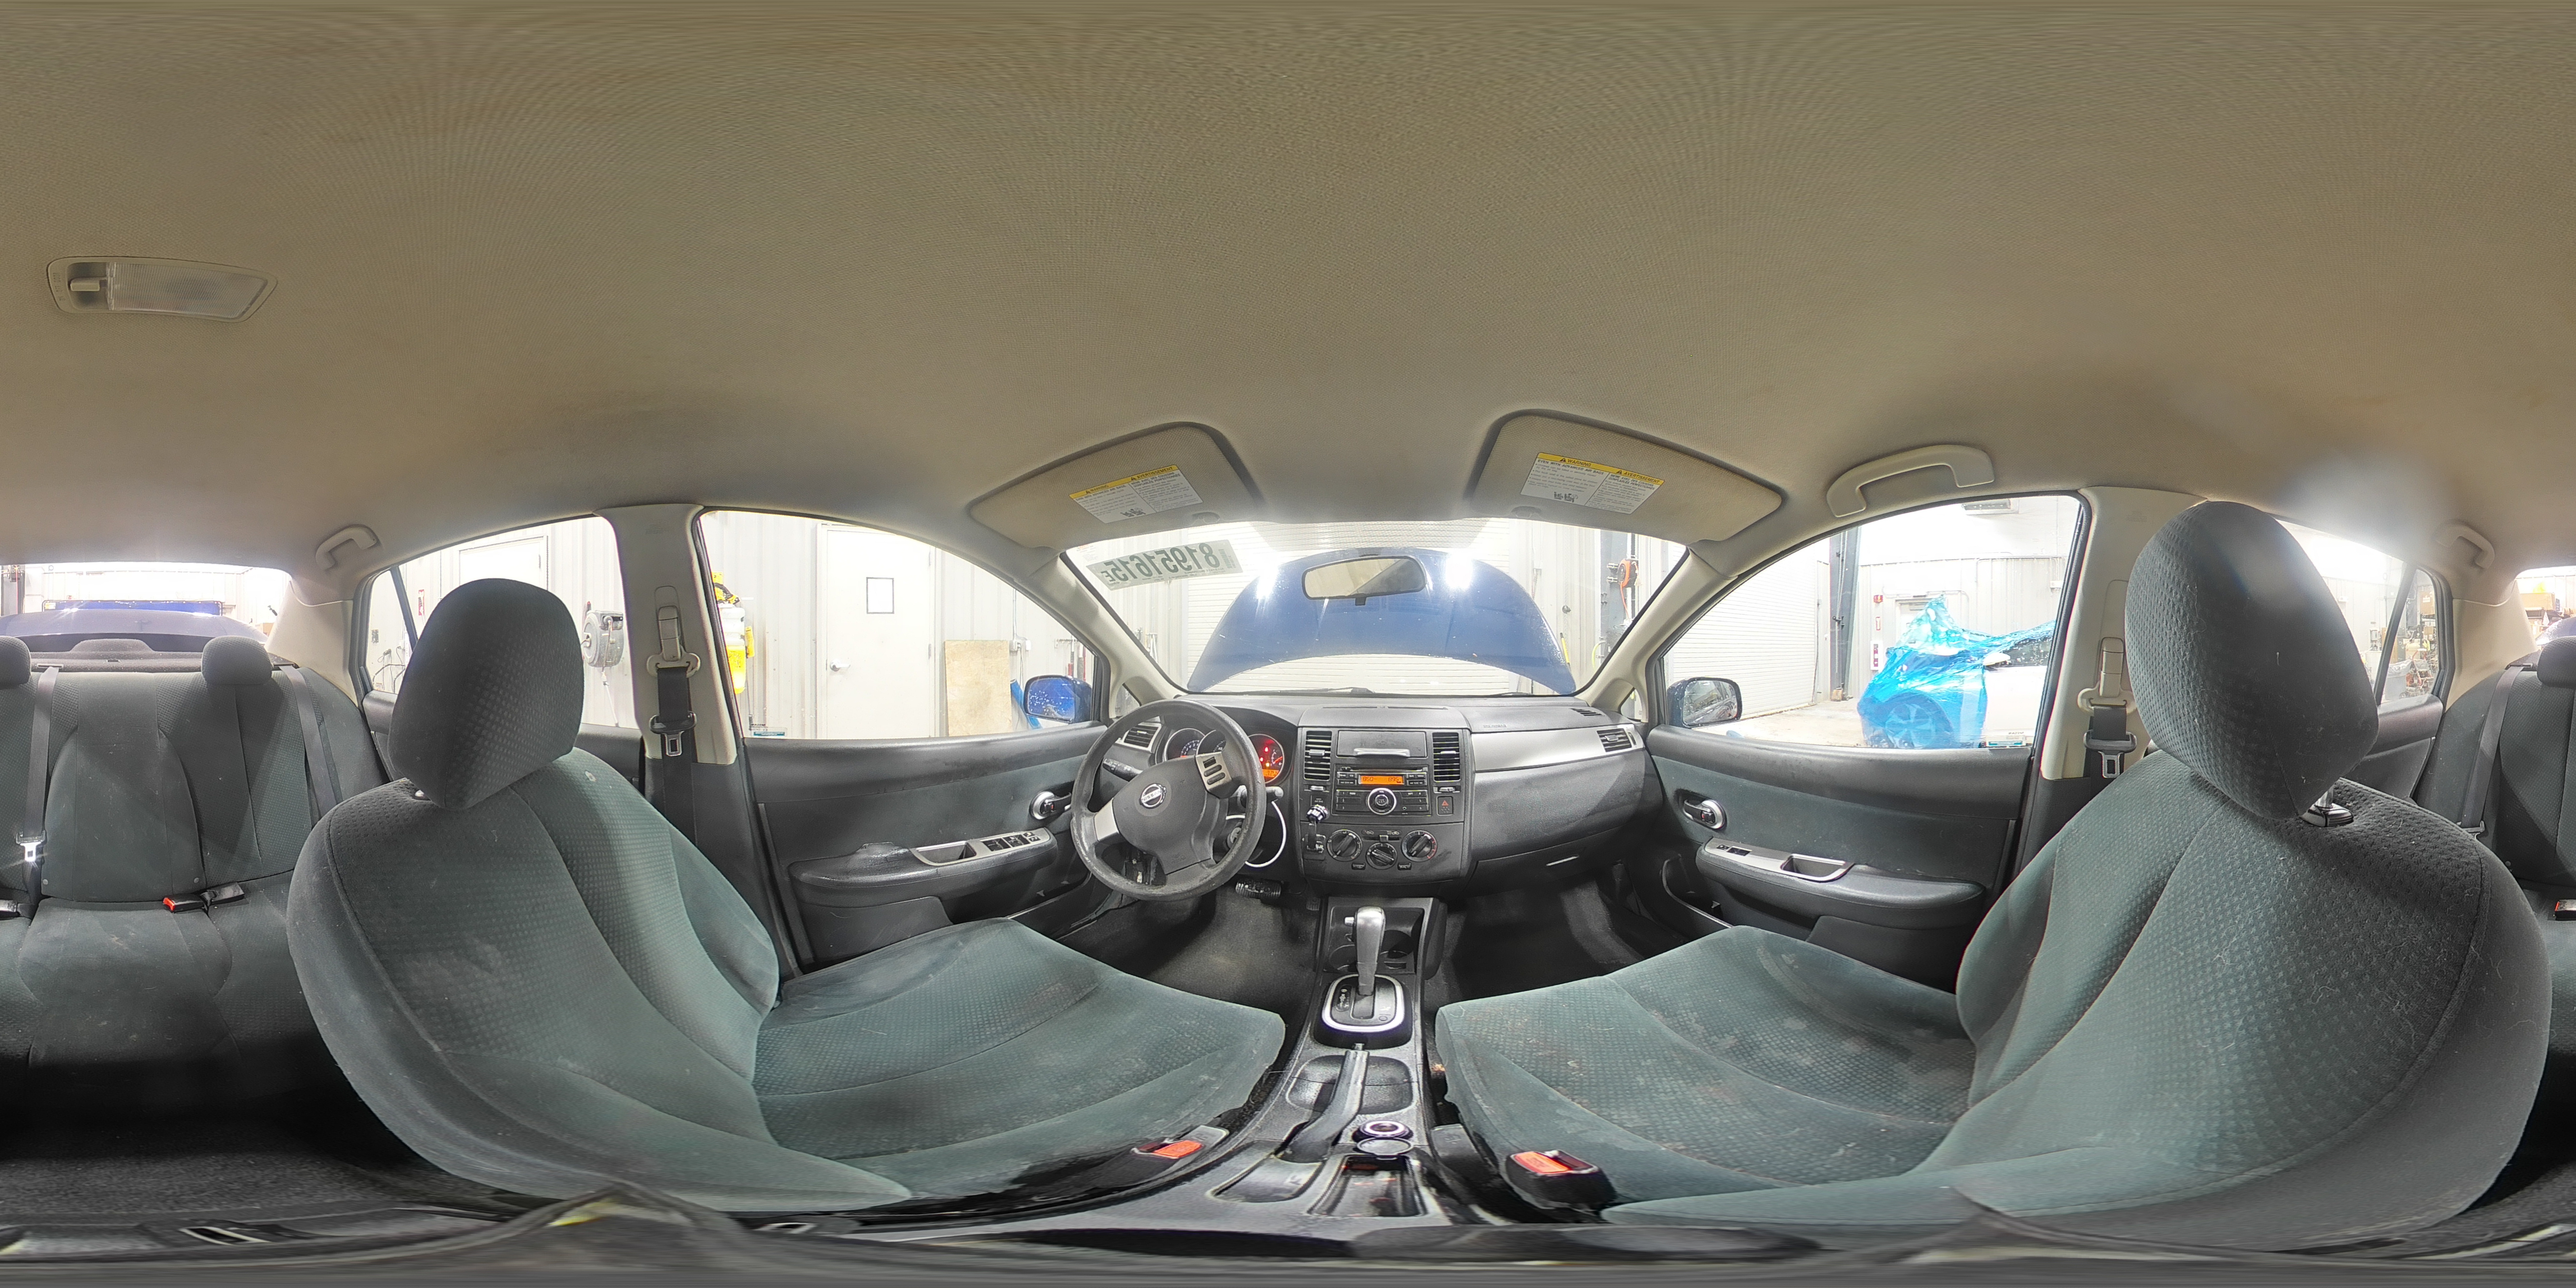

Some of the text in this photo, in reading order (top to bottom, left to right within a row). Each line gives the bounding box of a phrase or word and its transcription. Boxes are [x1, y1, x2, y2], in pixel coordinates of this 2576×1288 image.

[1567, 459, 1591, 467] WARNING
[1137, 467, 1173, 479] AVERTISSEMENT
[1623, 471, 1660, 483] AVERTISSEMENT
[1142, 791, 1162, 801] NISSAN
